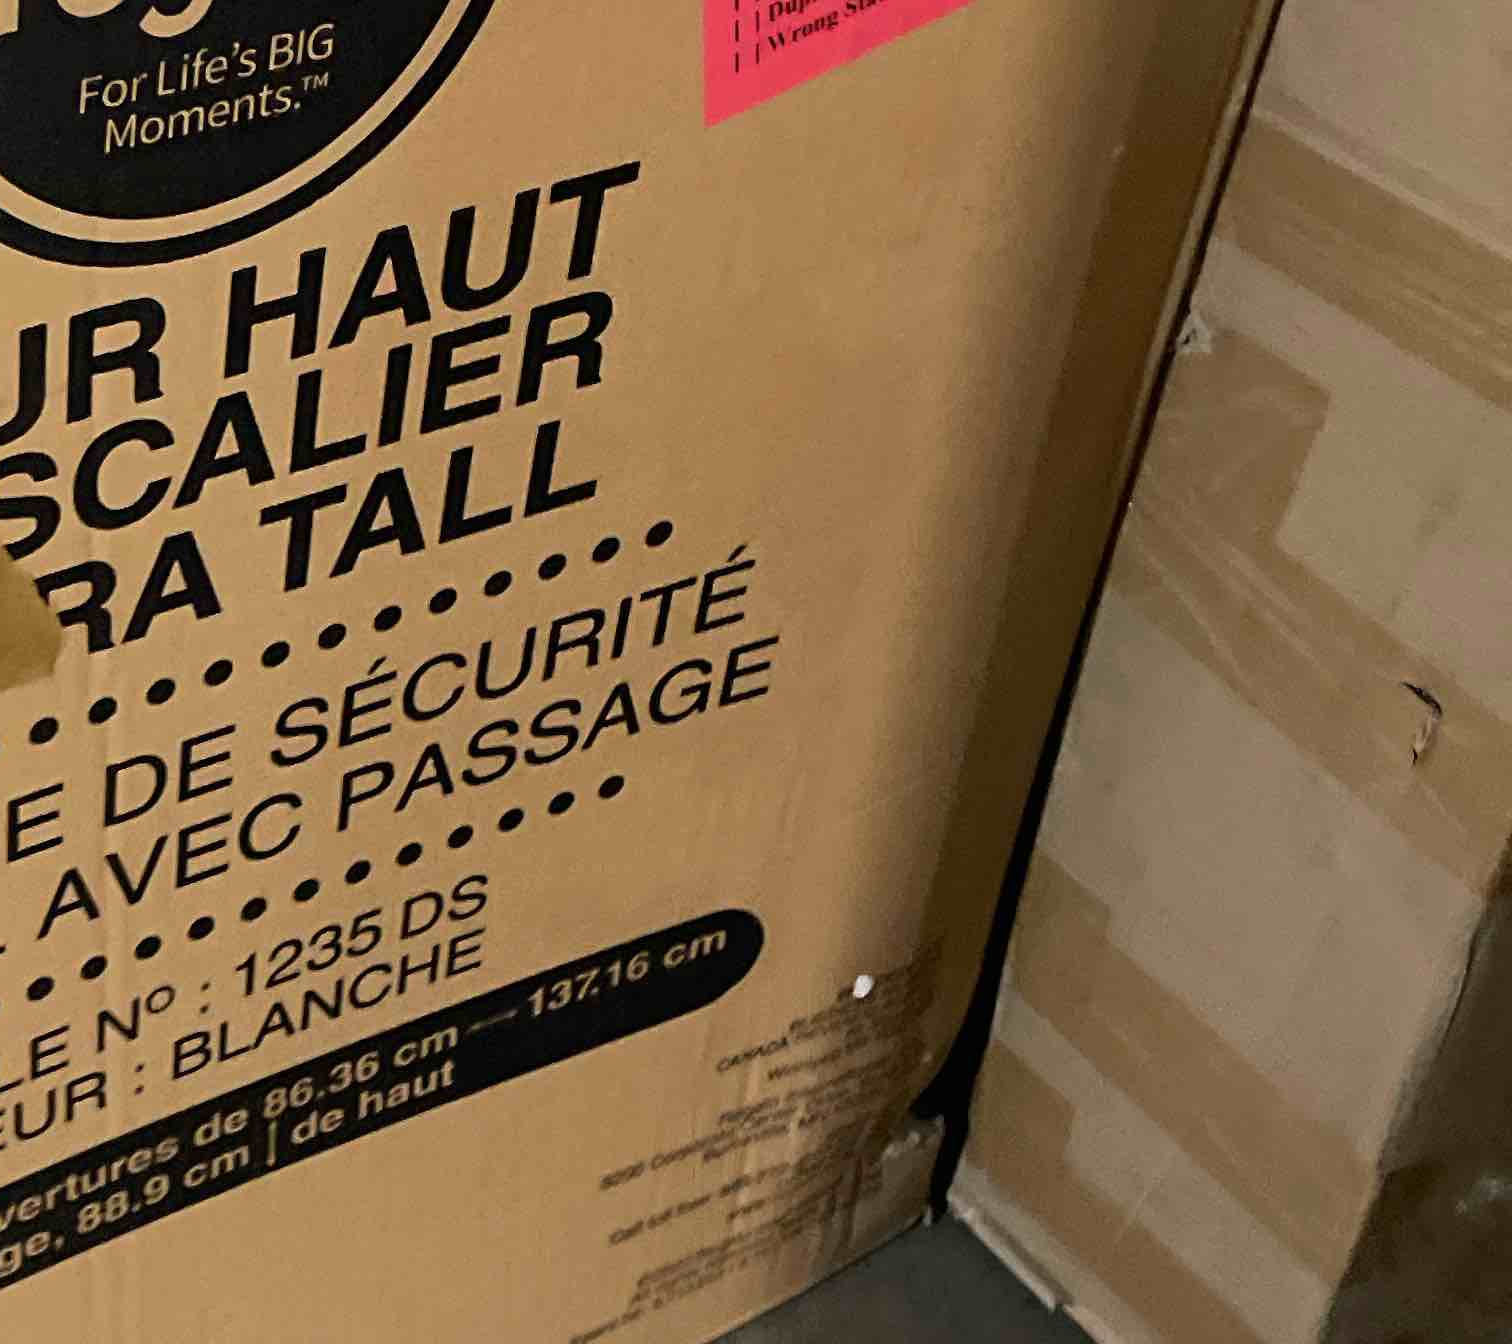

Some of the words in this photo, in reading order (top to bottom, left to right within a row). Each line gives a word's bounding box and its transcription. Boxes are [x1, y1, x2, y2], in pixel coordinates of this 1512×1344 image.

[78, 72, 148, 115] For
[155, 40, 257, 97] Life's
[267, 21, 336, 71] BIG
[768, 10, 839, 51] Wrong
[224, 161, 642, 379] HAUT
[260, 420, 598, 594] TALL
[103, 724, 236, 828] DE
[269, 544, 757, 768] SÉCURITÉ
[36, 792, 304, 941] AVEC
[336, 635, 780, 833] PASSAGE
[171, 928, 487, 1080] BLANCHE
[233, 907, 385, 998] 1235
[399, 872, 490, 941] DS
[193, 1104, 249, 1150] de
[262, 1052, 381, 1121] 86.36
[392, 1022, 462, 1070] cm
[525, 956, 651, 1021] 137.16
[662, 927, 729, 969] cm
[75, 1173, 172, 1238] 88.9
[182, 1141, 251, 1190] cm
[289, 1109, 346, 1150] de
[357, 1057, 457, 1123] haut
